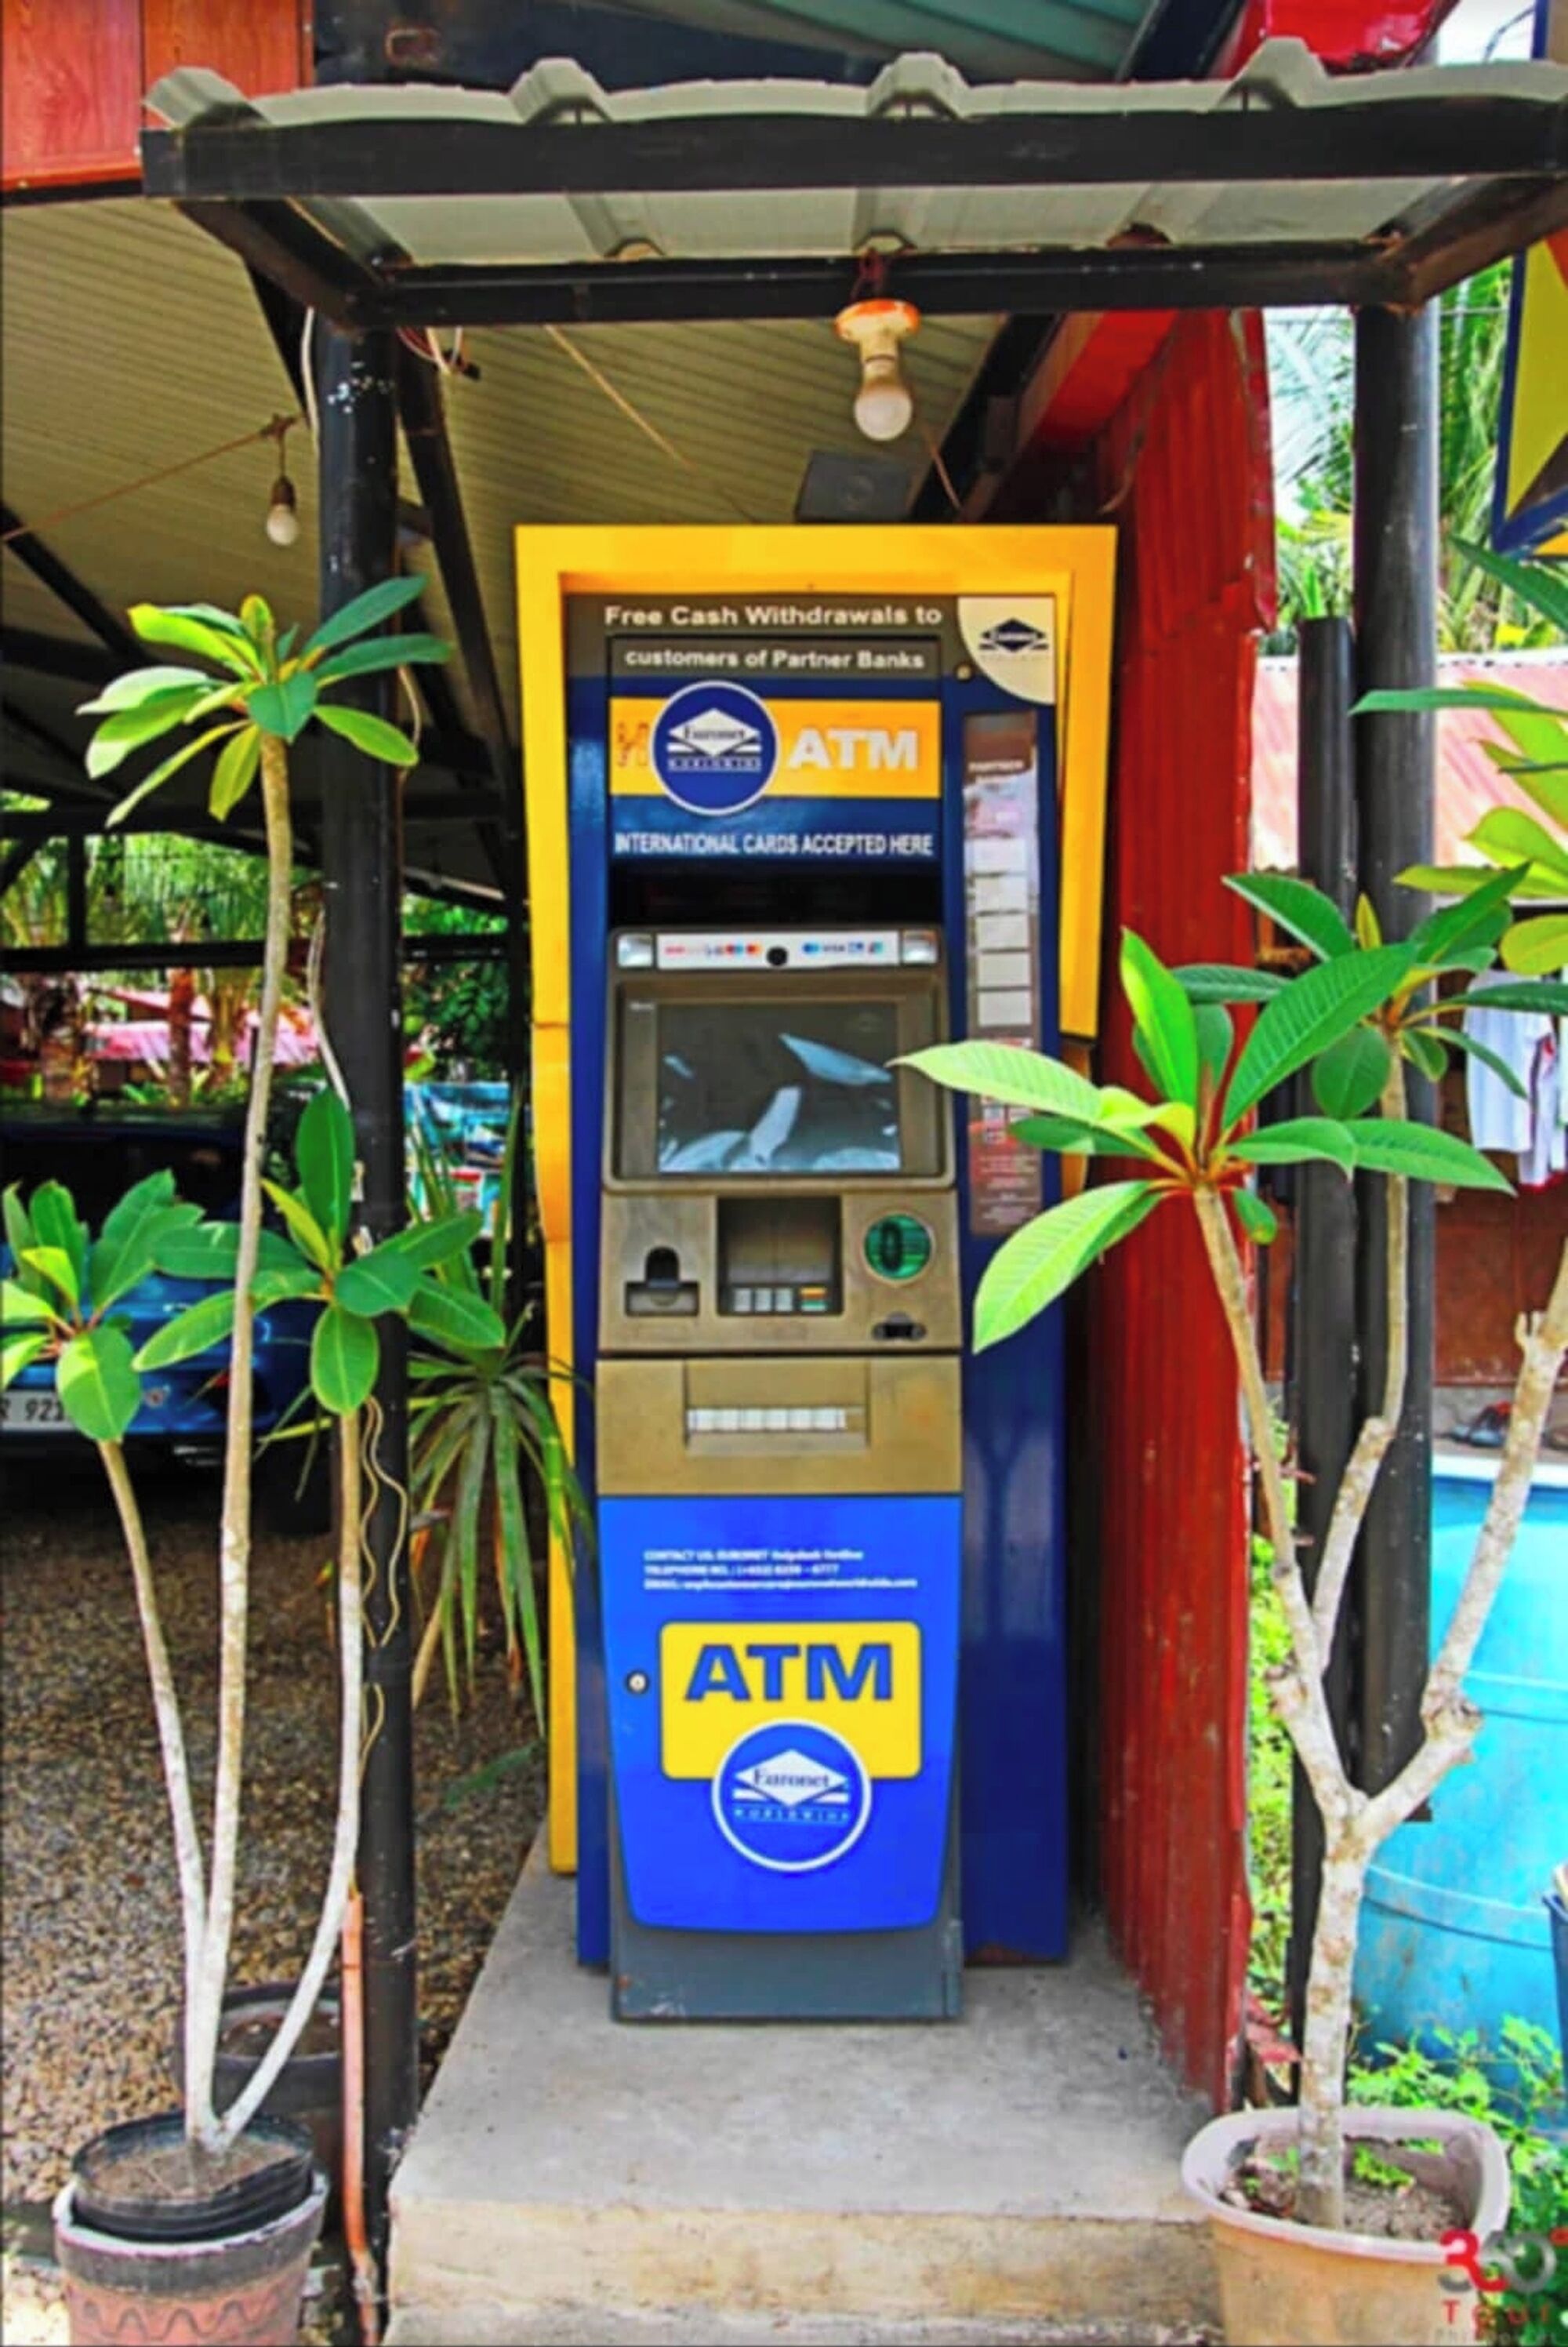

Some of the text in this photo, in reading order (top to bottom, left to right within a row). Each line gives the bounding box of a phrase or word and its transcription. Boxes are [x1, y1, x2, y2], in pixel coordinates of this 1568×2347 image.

[604, 605, 942, 626] Free Cash Withdrawals to
[625, 649, 925, 668] customers of Partner Banks
[788, 728, 918, 771] ATM
[615, 833, 933, 856] INTERNATIONAL CARDS ACCEPTED HERE
[684, 1643, 892, 1702] ATM
